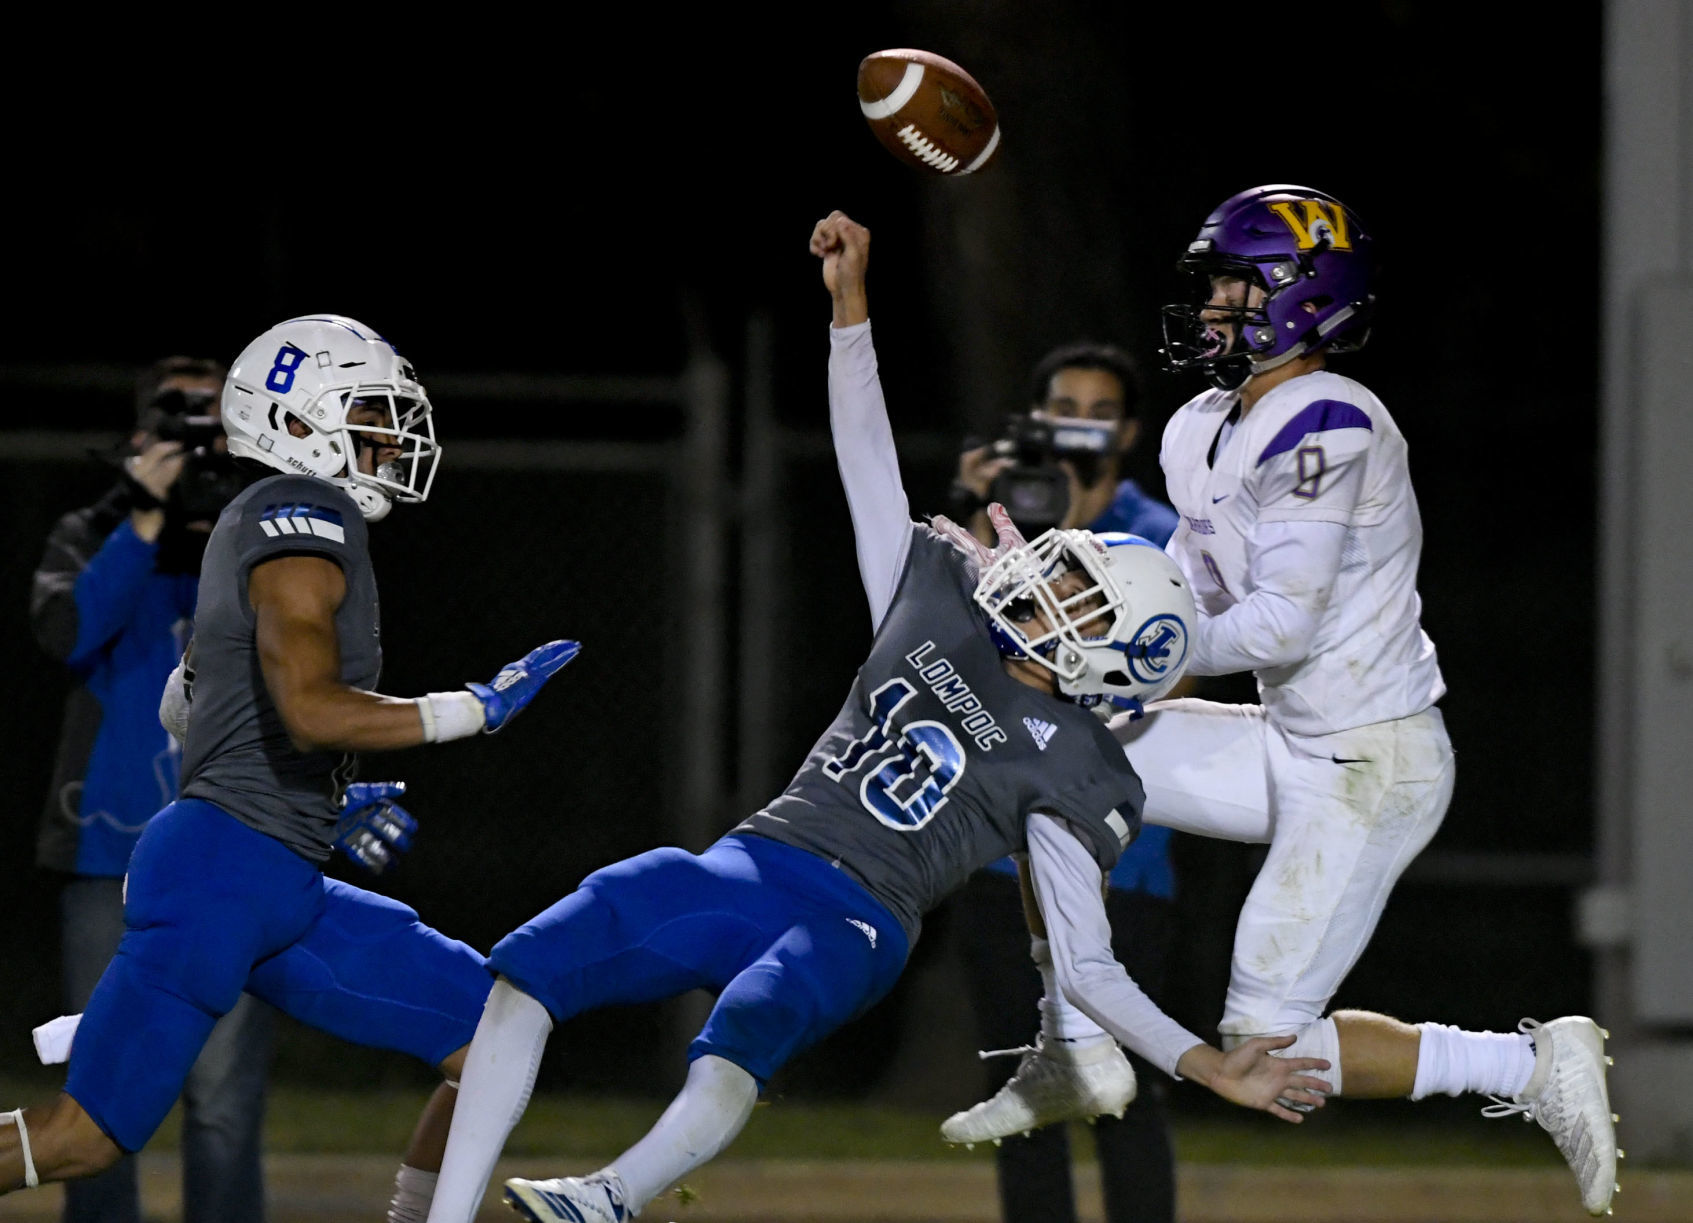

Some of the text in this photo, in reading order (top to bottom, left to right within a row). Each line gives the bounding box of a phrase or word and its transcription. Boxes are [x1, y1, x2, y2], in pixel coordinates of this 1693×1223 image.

[265, 345, 307, 394] 8
[905, 640, 1008, 752] LOMPOC
[1022, 716, 1048, 751] adidas
[822, 676, 967, 832] 10
